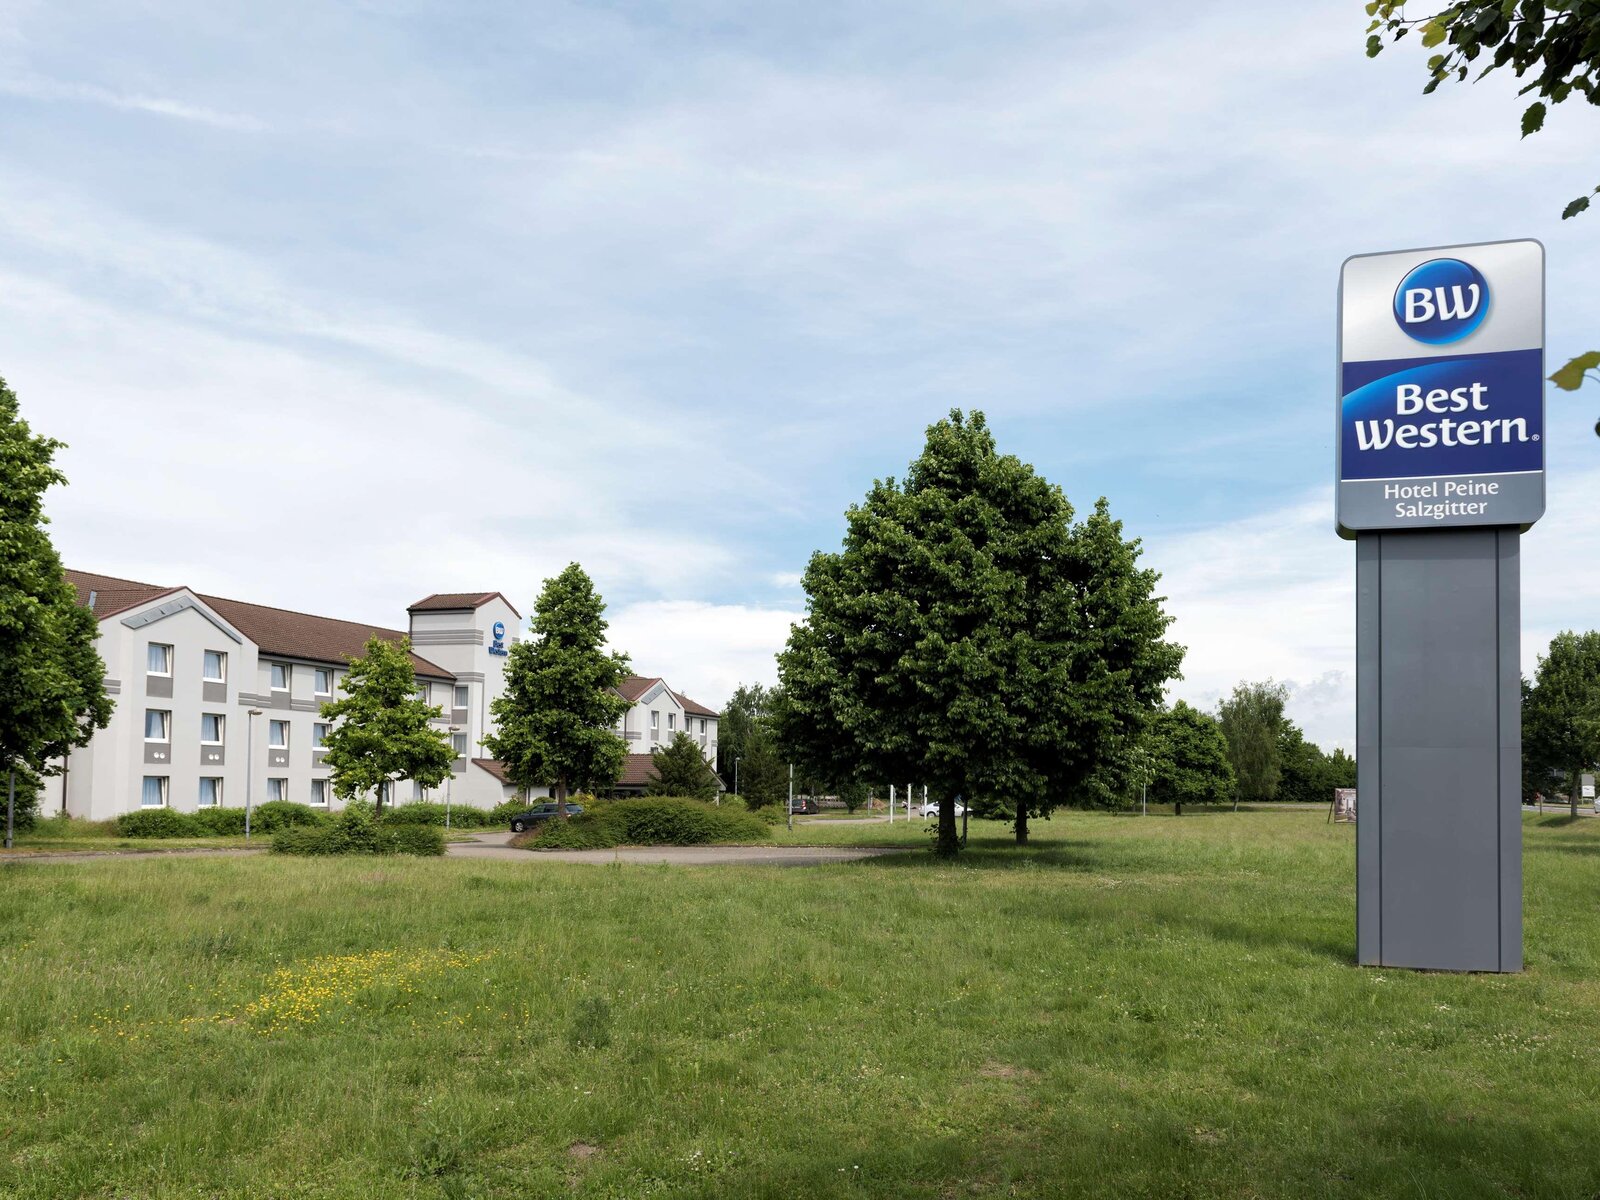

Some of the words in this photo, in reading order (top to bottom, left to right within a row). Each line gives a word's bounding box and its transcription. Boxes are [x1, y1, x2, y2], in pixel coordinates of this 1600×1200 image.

[1405, 283, 1480, 323] BW
[1396, 382, 1489, 415] Best
[1384, 482, 1438, 499] Hotel
[1444, 480, 1499, 497] Peine
[1395, 500, 1488, 520] Salzgitter
